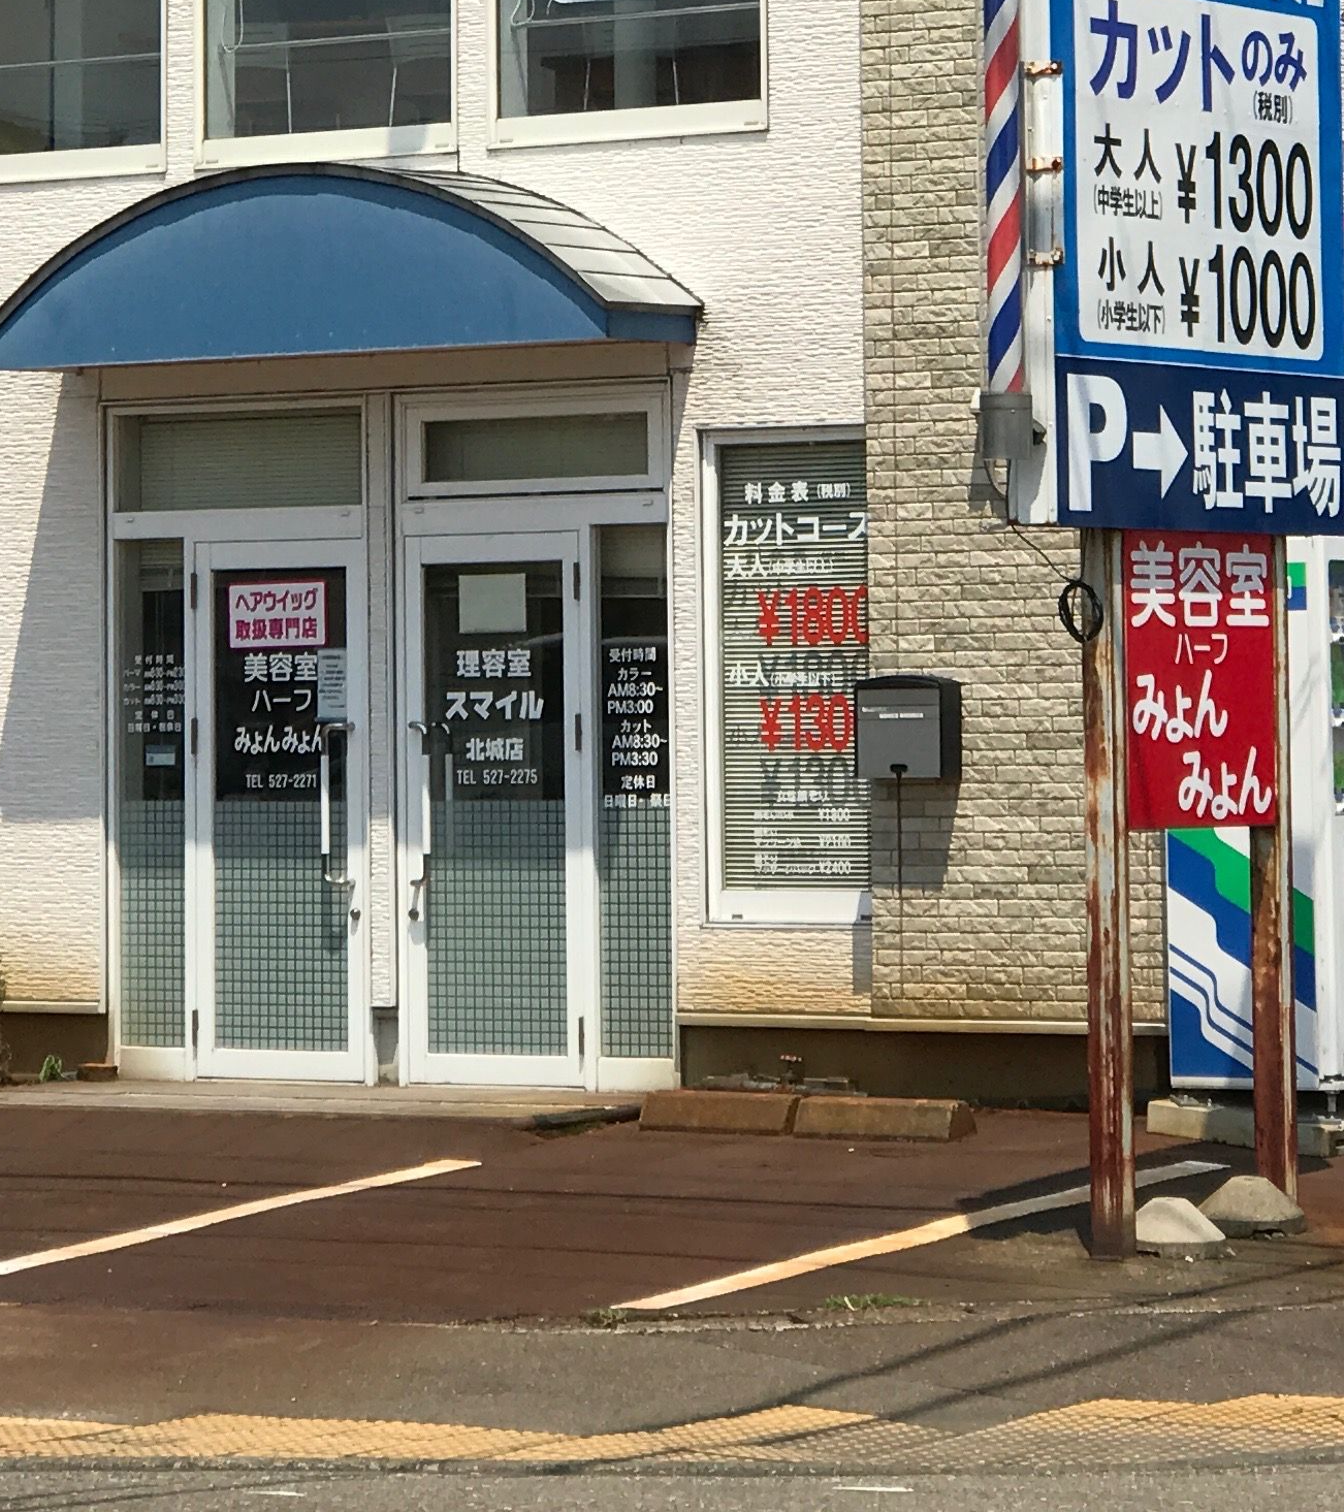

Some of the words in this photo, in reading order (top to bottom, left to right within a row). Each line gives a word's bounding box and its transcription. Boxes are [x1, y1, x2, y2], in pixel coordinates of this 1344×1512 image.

[1253, 89, 1293, 126] (税別)
[1093, 122, 1163, 184] 大人
[1175, 130, 1313, 241] ¥1300
[1092, 184, 1164, 221] (中学生以上)
[1097, 235, 1166, 297] 小人
[1178, 243, 1316, 351] ¥1000
[1066, 372, 1128, 512] P
[1191, 388, 1342, 519] 駐車場
[744, 480, 809, 505] 料金表
[723, 512, 866, 547] カットコース
[1129, 541, 1271, 629] 美容室
[456, 648, 532, 679] 理容室
[1174, 632, 1229, 666] ハーフ
[243, 650, 319, 683] 美容室
[617, 667, 652, 681] カラー
[251, 688, 312, 714] ハーフ
[444, 689, 545, 721] スマイル
[1131, 668, 1229, 744] みょん
[619, 718, 653, 733] カット
[758, 692, 854, 752] ¥130
[233, 723, 323, 756] みょんみょん
[464, 737, 525, 761] 北城店
[245, 773, 264, 789] TEL
[456, 769, 477, 785] TEL
[483, 768, 538, 785] 527-2275
[1177, 744, 1273, 821] みょん
